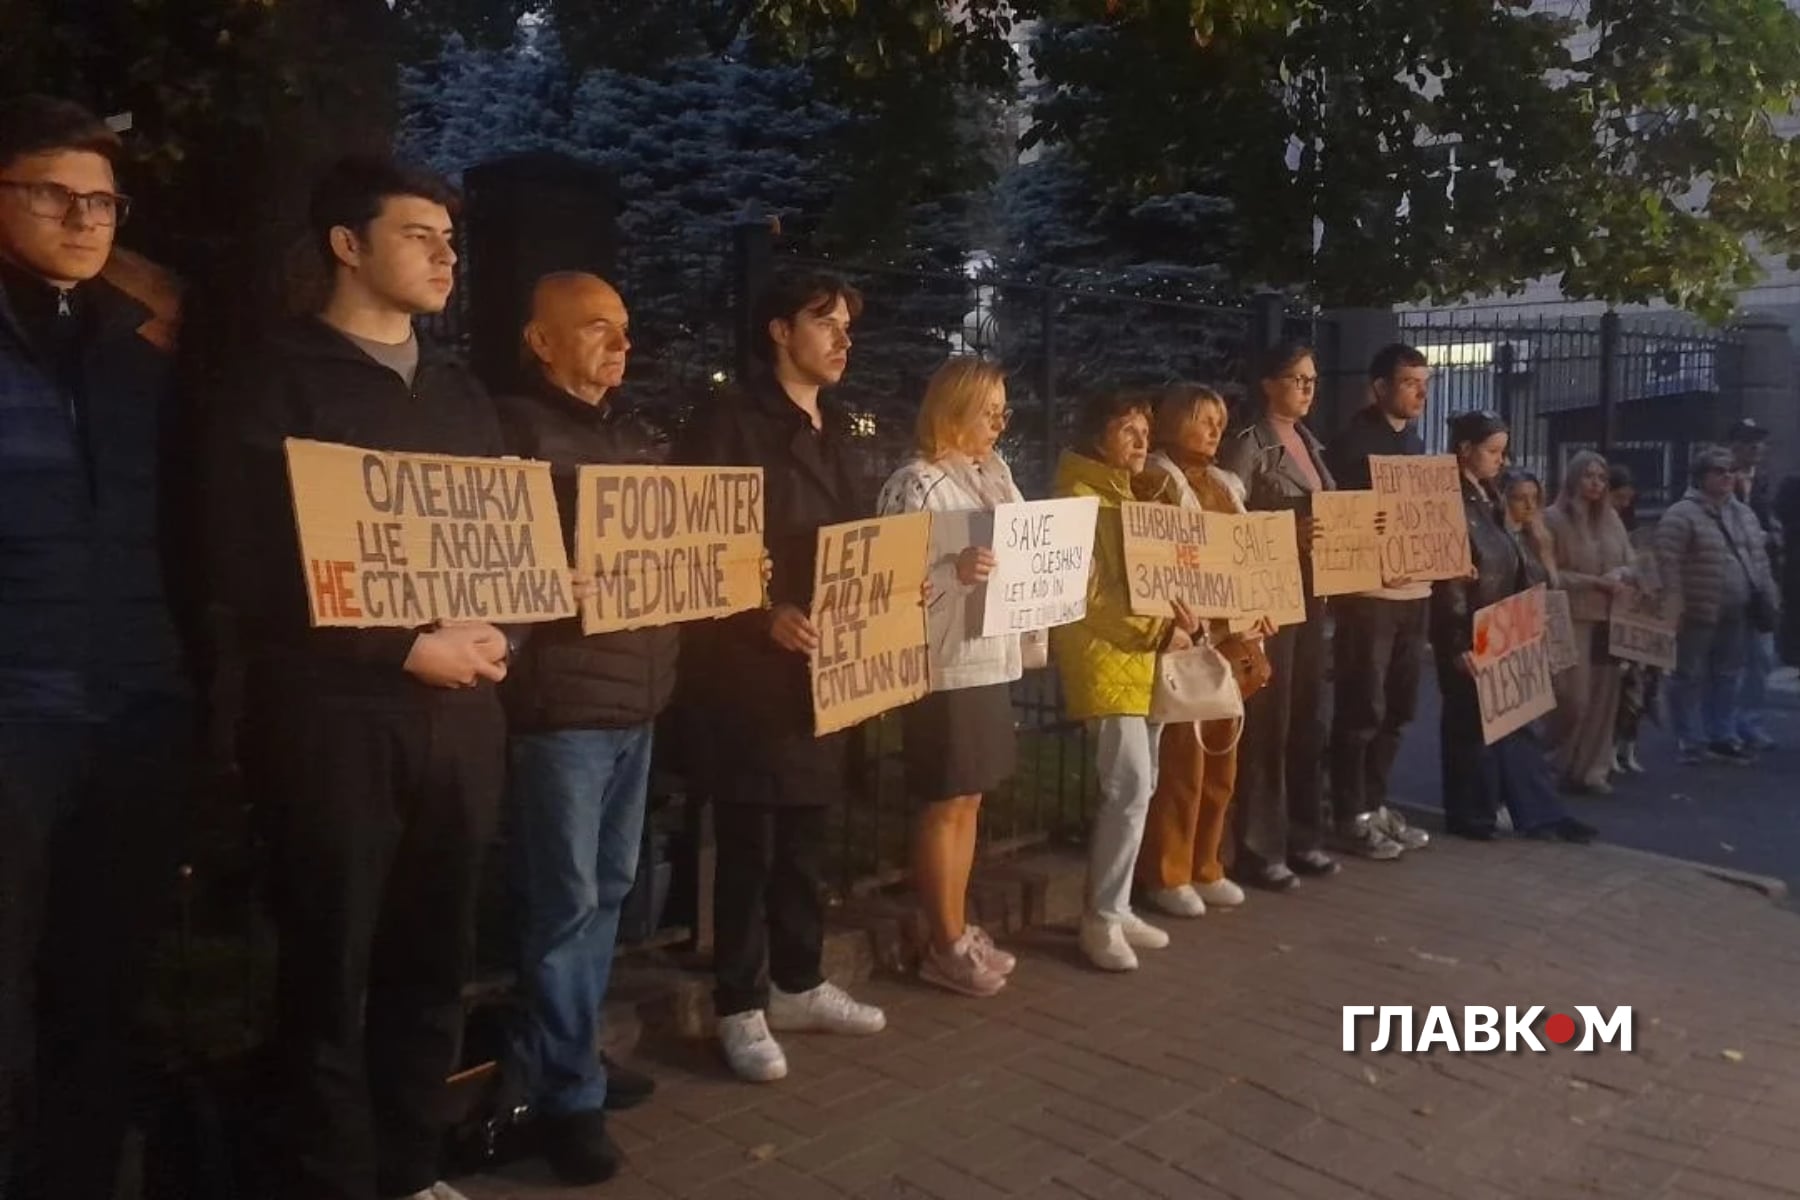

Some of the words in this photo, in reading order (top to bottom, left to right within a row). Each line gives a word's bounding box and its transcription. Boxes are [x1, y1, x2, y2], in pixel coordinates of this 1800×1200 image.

[362, 454, 534, 521] ОЛЕШКИ
[1374, 463, 1402, 495] HELP
[357, 520, 408, 571] ЦЕ
[430, 523, 536, 570] ЛЮДИ
[821, 525, 880, 585] LET
[1007, 514, 1054, 551] SAVE
[1175, 545, 1200, 569] НЕ
[1232, 516, 1279, 566] SAVE
[1386, 531, 1468, 575] OLESHKY
[1032, 546, 1083, 574] OLESHKY
[312, 559, 362, 618] НЕ
[362, 568, 569, 619] СТАТИСТИКА
[818, 577, 862, 628] AID
[869, 570, 894, 616] IN
[1005, 582, 1025, 602] LET
[1031, 577, 1049, 599] AID
[1237, 568, 1300, 613] LESHKY
[818, 619, 867, 669] LET
[817, 651, 895, 710] CIVILIAN
[899, 644, 930, 688] OUT
